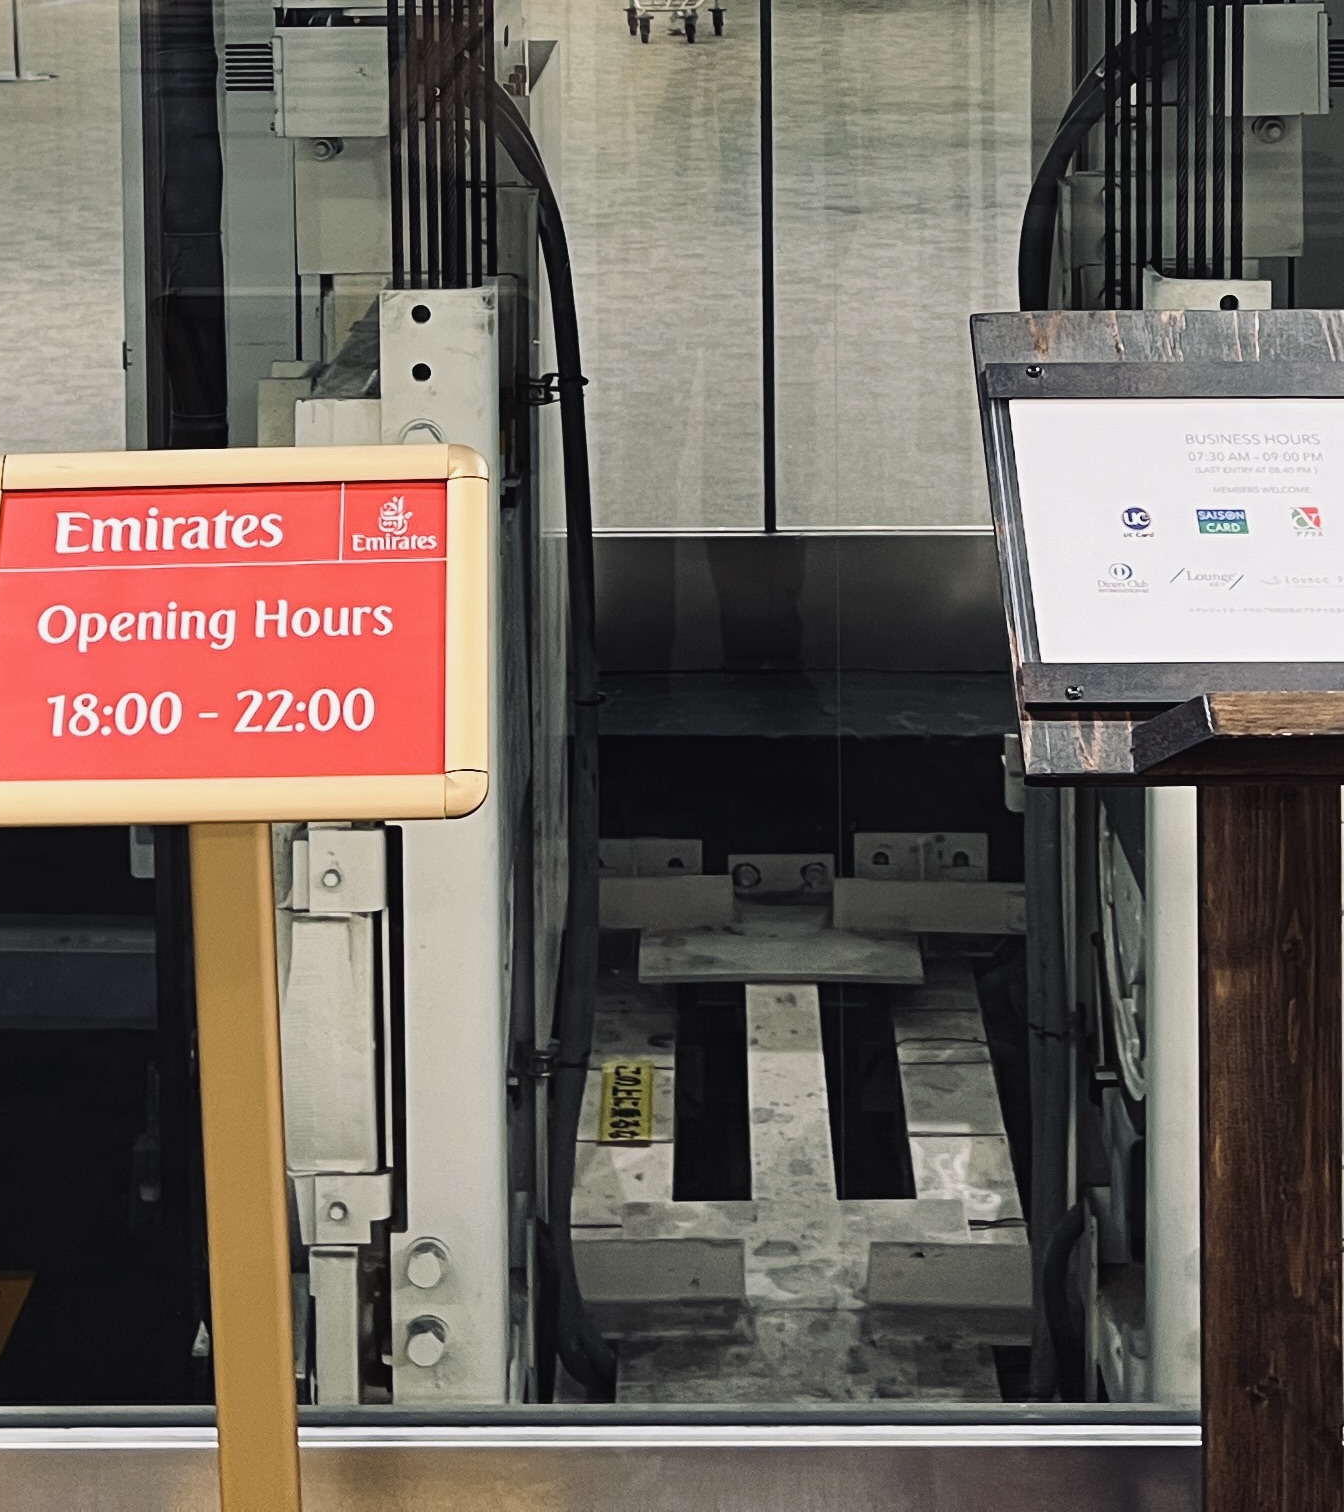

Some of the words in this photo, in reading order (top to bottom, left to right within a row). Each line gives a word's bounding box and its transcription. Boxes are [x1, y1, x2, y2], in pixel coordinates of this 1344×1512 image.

[1184, 433, 1261, 445] BUSINESS
[1264, 433, 1321, 445] HOURS
[1228, 451, 1251, 462] AM
[1302, 451, 1324, 462] PM
[1197, 510, 1246, 521] SAISON
[55, 507, 284, 554] Emirates
[1205, 522, 1242, 533] CARD
[351, 533, 438, 552] Emirates
[37, 601, 236, 653] Opening
[255, 599, 394, 639] Hours
[47, 691, 183, 737] 18:00
[234, 687, 375, 733] 22:00
